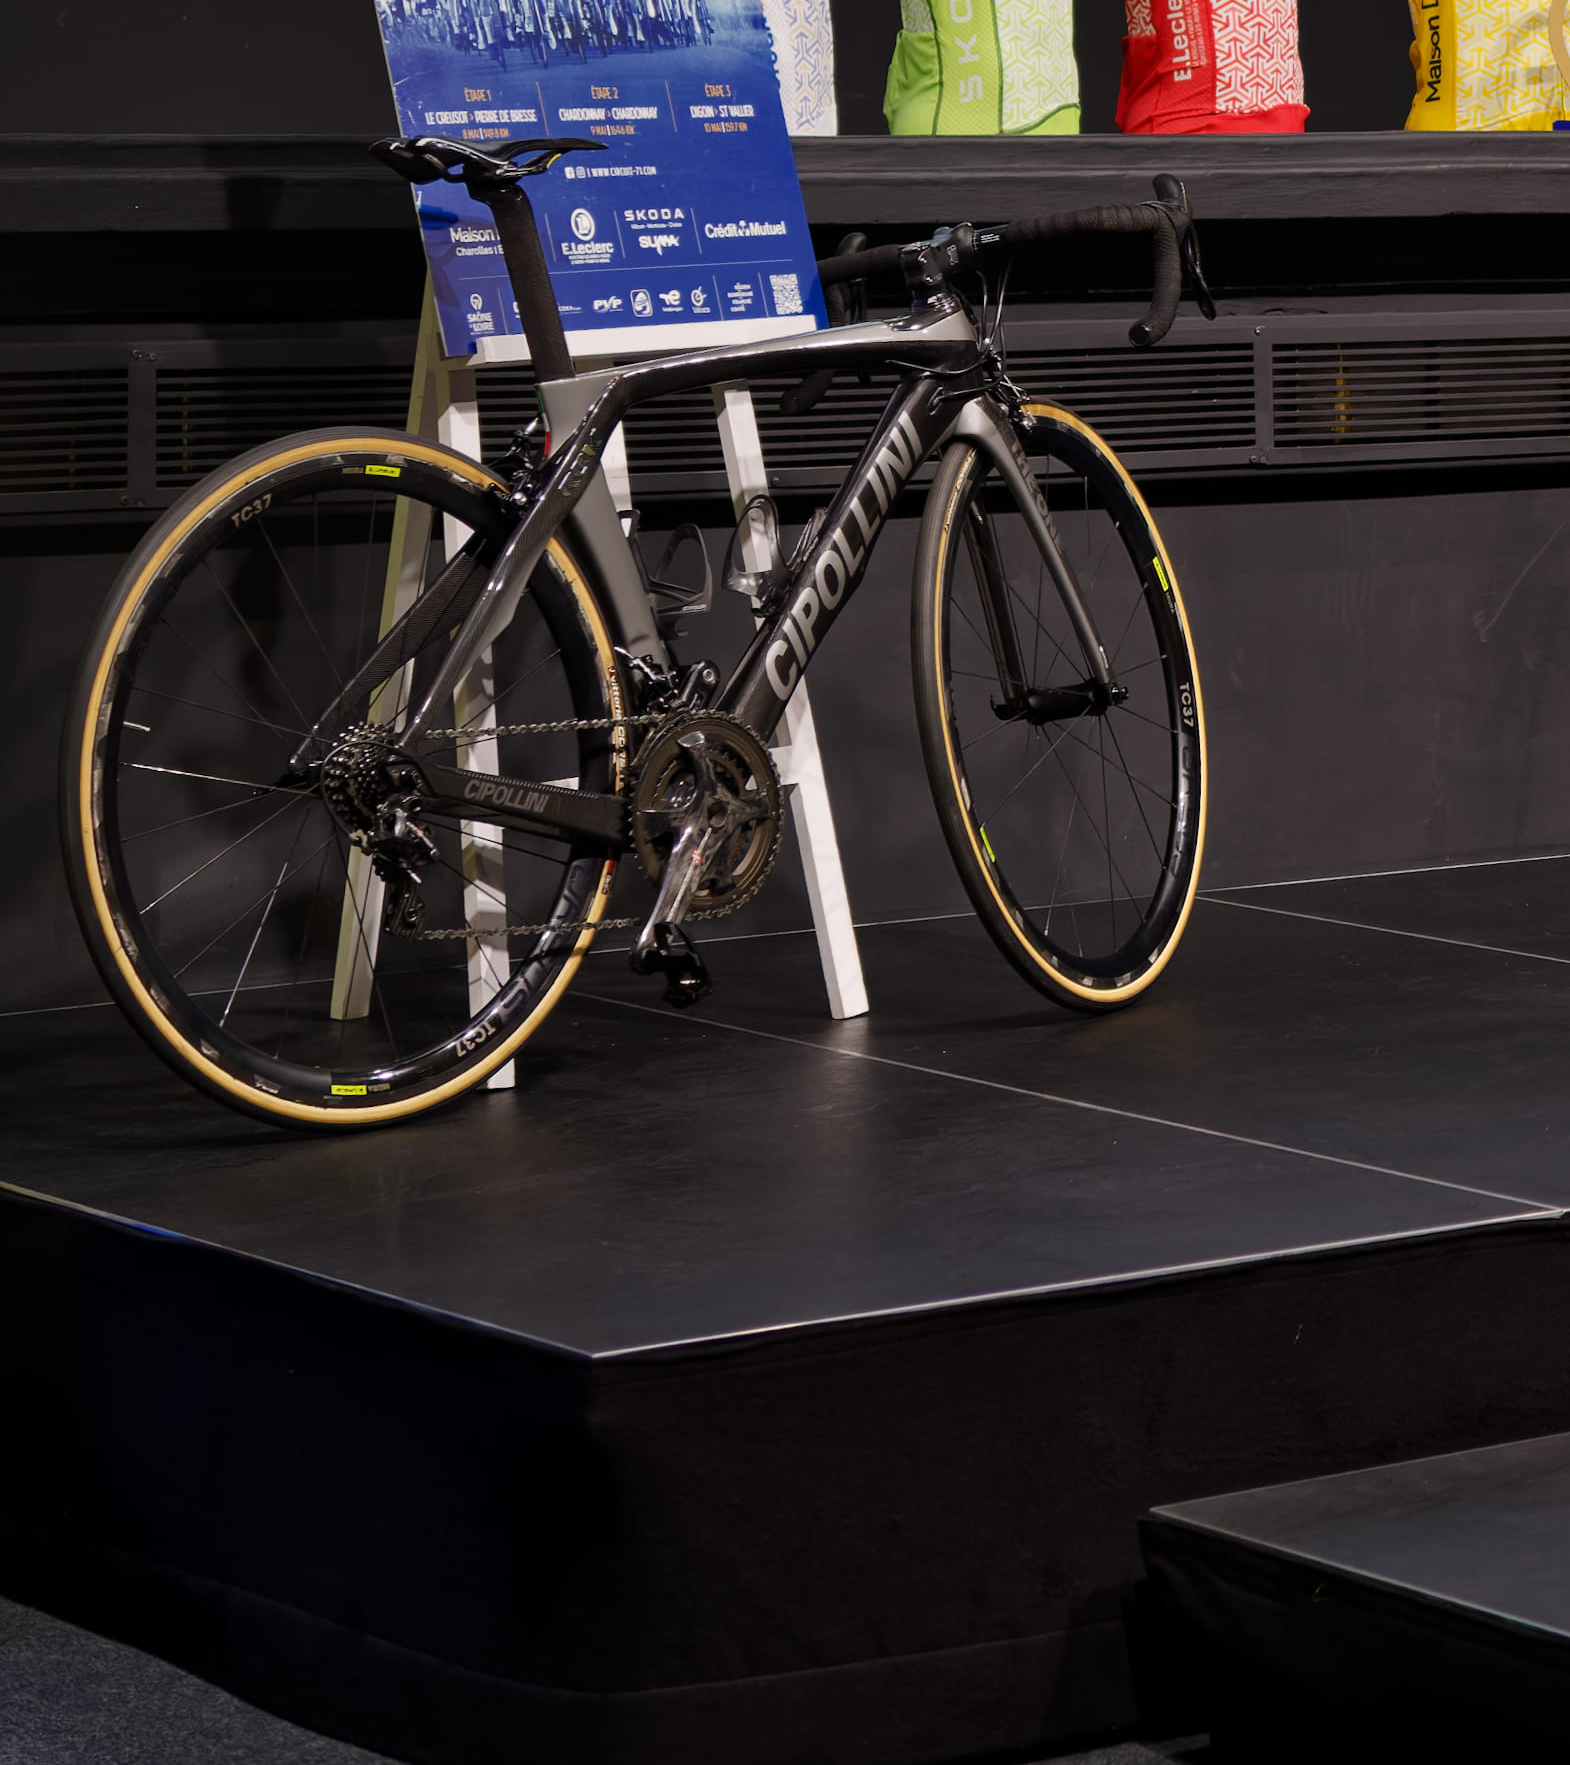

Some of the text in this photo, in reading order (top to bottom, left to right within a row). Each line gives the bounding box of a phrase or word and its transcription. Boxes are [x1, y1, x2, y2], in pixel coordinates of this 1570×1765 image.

[1424, 15, 1441, 103] Maison
[449, 227, 495, 243] Maison
[704, 220, 787, 239] Crédit Mutuel
[561, 241, 615, 255] E.Leclerc
[231, 493, 272, 527] TC37
[765, 410, 924, 701] CIPOLLINI
[1178, 681, 1194, 728] TC37
[463, 779, 550, 814] CIPOLLINI
